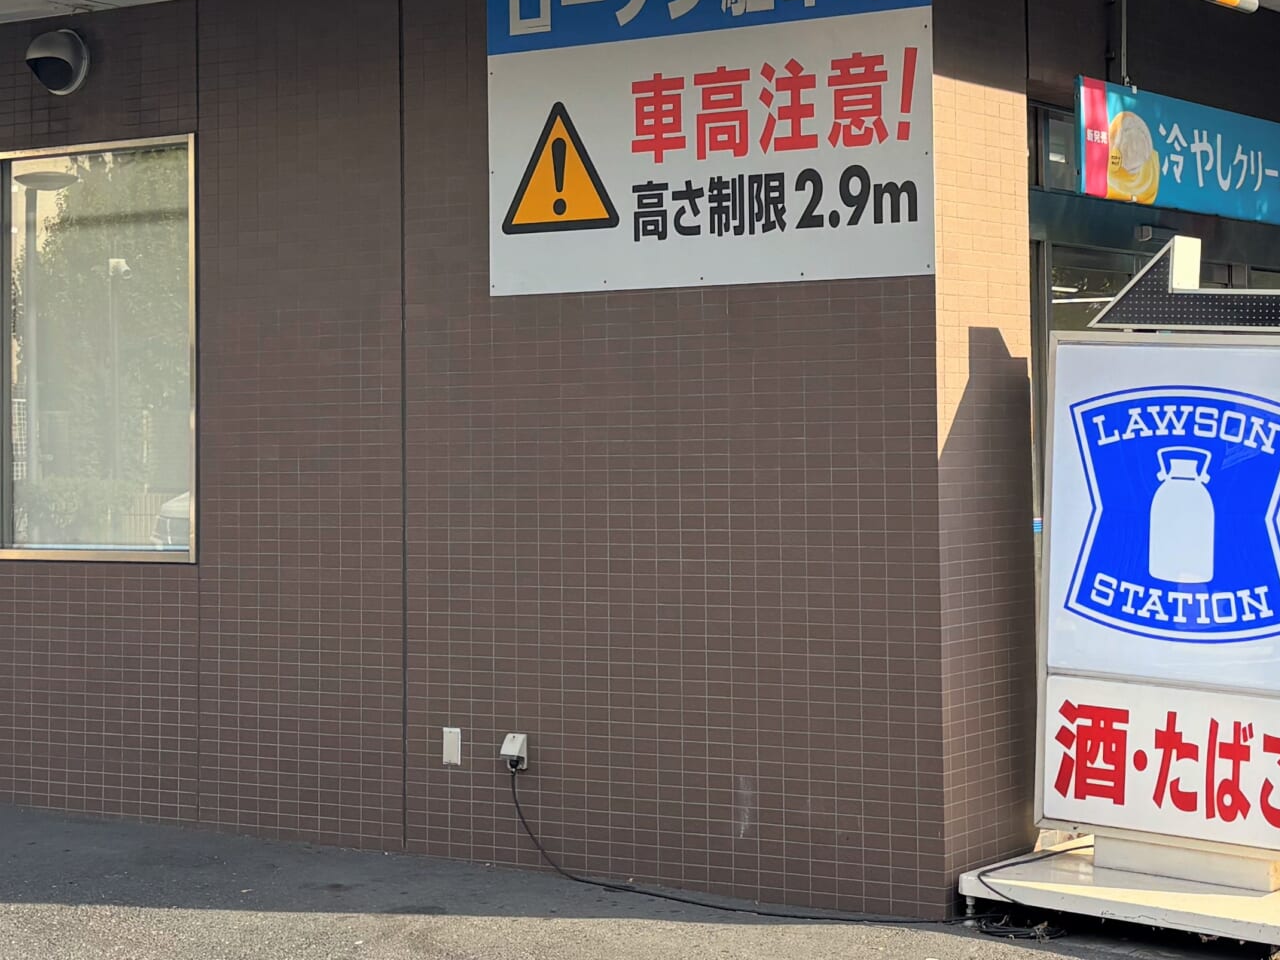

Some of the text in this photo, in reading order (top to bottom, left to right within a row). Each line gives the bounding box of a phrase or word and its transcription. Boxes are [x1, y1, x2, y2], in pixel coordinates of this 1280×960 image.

[631, 47, 918, 164] 車高注意!
[631, 165, 918, 241] 高さ制限2.9m
[1090, 572, 1274, 624] STATION
